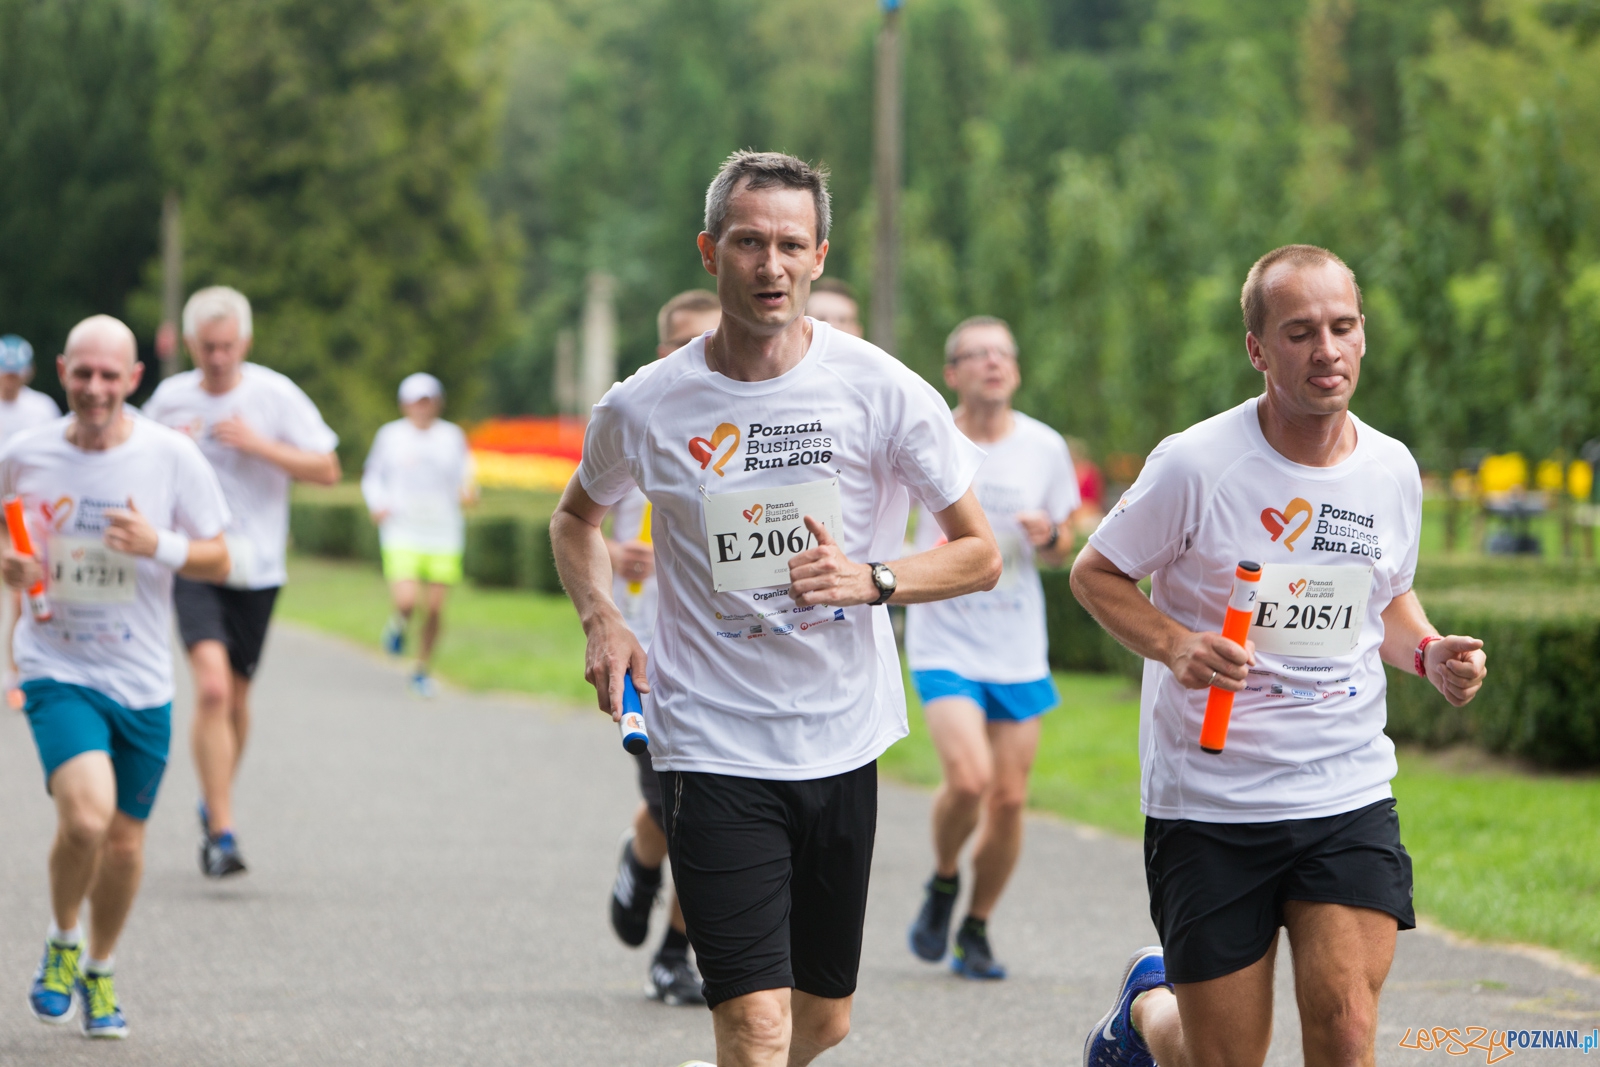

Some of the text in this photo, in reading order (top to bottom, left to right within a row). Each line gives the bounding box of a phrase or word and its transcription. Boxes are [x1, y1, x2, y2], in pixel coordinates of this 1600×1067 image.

[748, 420, 822, 438] Poznań
[745, 437, 832, 455] Business
[743, 451, 833, 472] Run 2016
[765, 512, 799, 524] Run 2016
[1319, 504, 1375, 529] Poznań
[713, 532, 742, 564] E
[748, 522, 824, 560] 206/
[1315, 520, 1379, 546] Business
[1311, 536, 1382, 560] Run 2016
[1304, 591, 1319, 599] Run
[1252, 601, 1279, 629] E
[1284, 604, 1354, 630] 205/1
